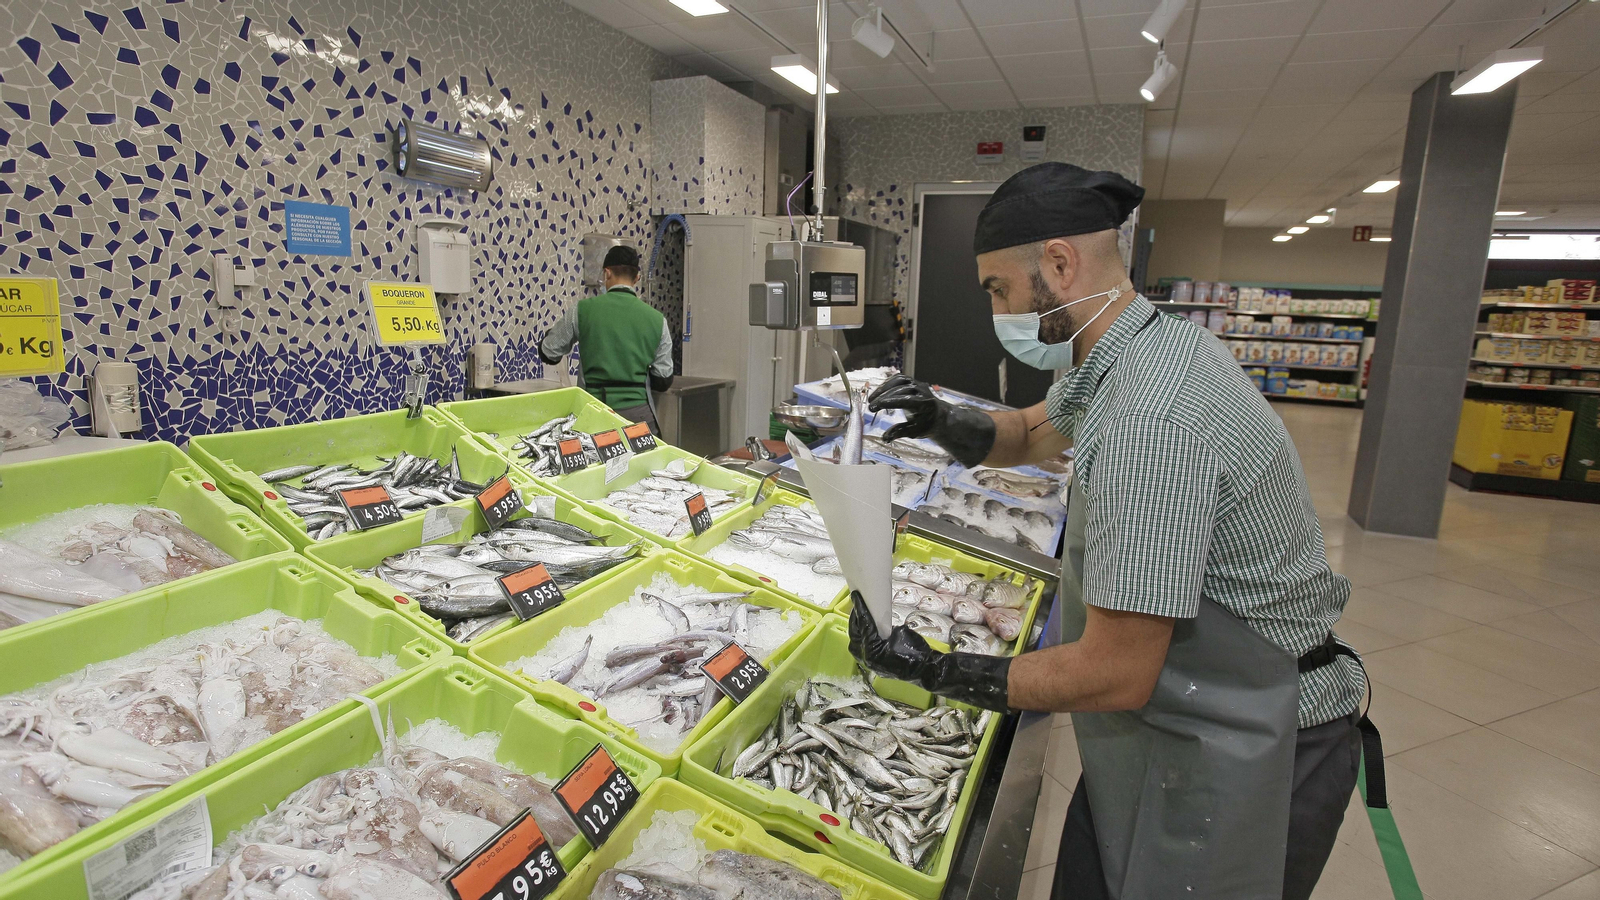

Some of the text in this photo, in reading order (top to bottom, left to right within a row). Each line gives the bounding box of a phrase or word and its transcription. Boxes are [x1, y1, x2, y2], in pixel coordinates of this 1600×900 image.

[382, 290, 424, 298] BOQUERON
[426, 320, 440, 333] Kg
[20, 337, 54, 358] Kg
[364, 504, 396, 520] 4,50€
[494, 492, 517, 518] 3,95€
[522, 583, 556, 605] 3,95€
[731, 660, 757, 689] 2,95€
[574, 771, 584, 782] SEPIA
[583, 763, 594, 774] LONJA
[584, 774, 627, 834] 12,95€
[477, 852, 496, 869] PULPO
[496, 834, 517, 853] BLANCO
